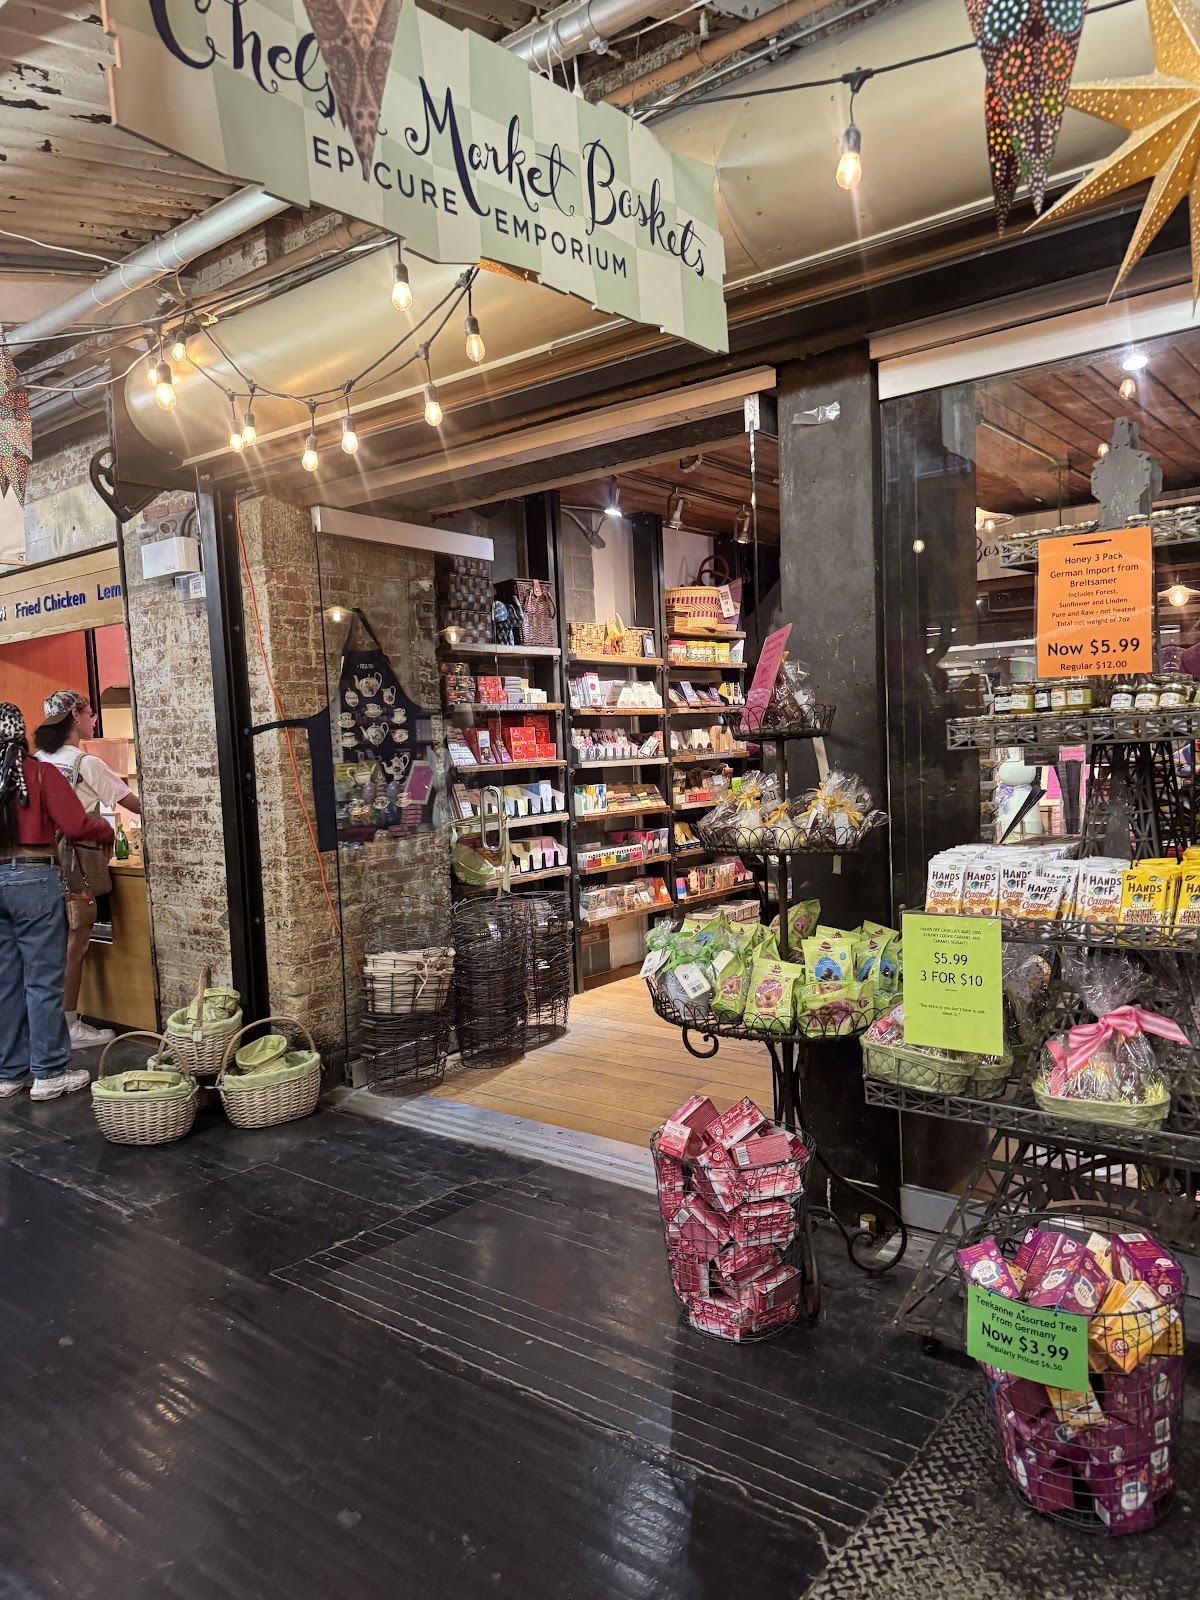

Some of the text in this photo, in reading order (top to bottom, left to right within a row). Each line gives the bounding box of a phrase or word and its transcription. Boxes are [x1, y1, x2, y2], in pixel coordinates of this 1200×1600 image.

[405, 75, 577, 217] Market
[582, 139, 706, 281] Baskets
[313, 136, 627, 278] EPCURE EMPORIUM
[1065, 551, 1123, 565] Honey 3 Pack
[1050, 563, 1139, 579] German Import from
[1069, 577, 1118, 588] Breitsamer
[1068, 590, 1094, 598] Includes
[15, 596, 41, 618] Fried
[44, 591, 86, 612] Chicken
[1059, 597, 1128, 609] Sunflower and Linden
[1112, 606, 1136, 614] heated
[1056, 620, 1073, 628] Total
[1086, 617, 1108, 627] weight
[1047, 637, 1140, 657] Now $5.99
[1060, 660, 1127, 672] Regular $12.00
[932, 871, 960, 880] HANDS
[967, 871, 996, 881] HANDS
[1089, 875, 1122, 886] HANDS
[1027, 884, 1058, 893] HANDS
[1127, 882, 1162, 893] HANDS
[934, 951, 968, 966] $5.99
[920, 970, 983, 987] 3 FOR $10
[975, 1294, 1077, 1333] Teekanne Assorted Tea
[991, 1312, 1056, 1341] From Germany
[981, 1322, 1069, 1361] Now $3.99
[986, 1341, 1062, 1371] Regularly Priced $6.50
